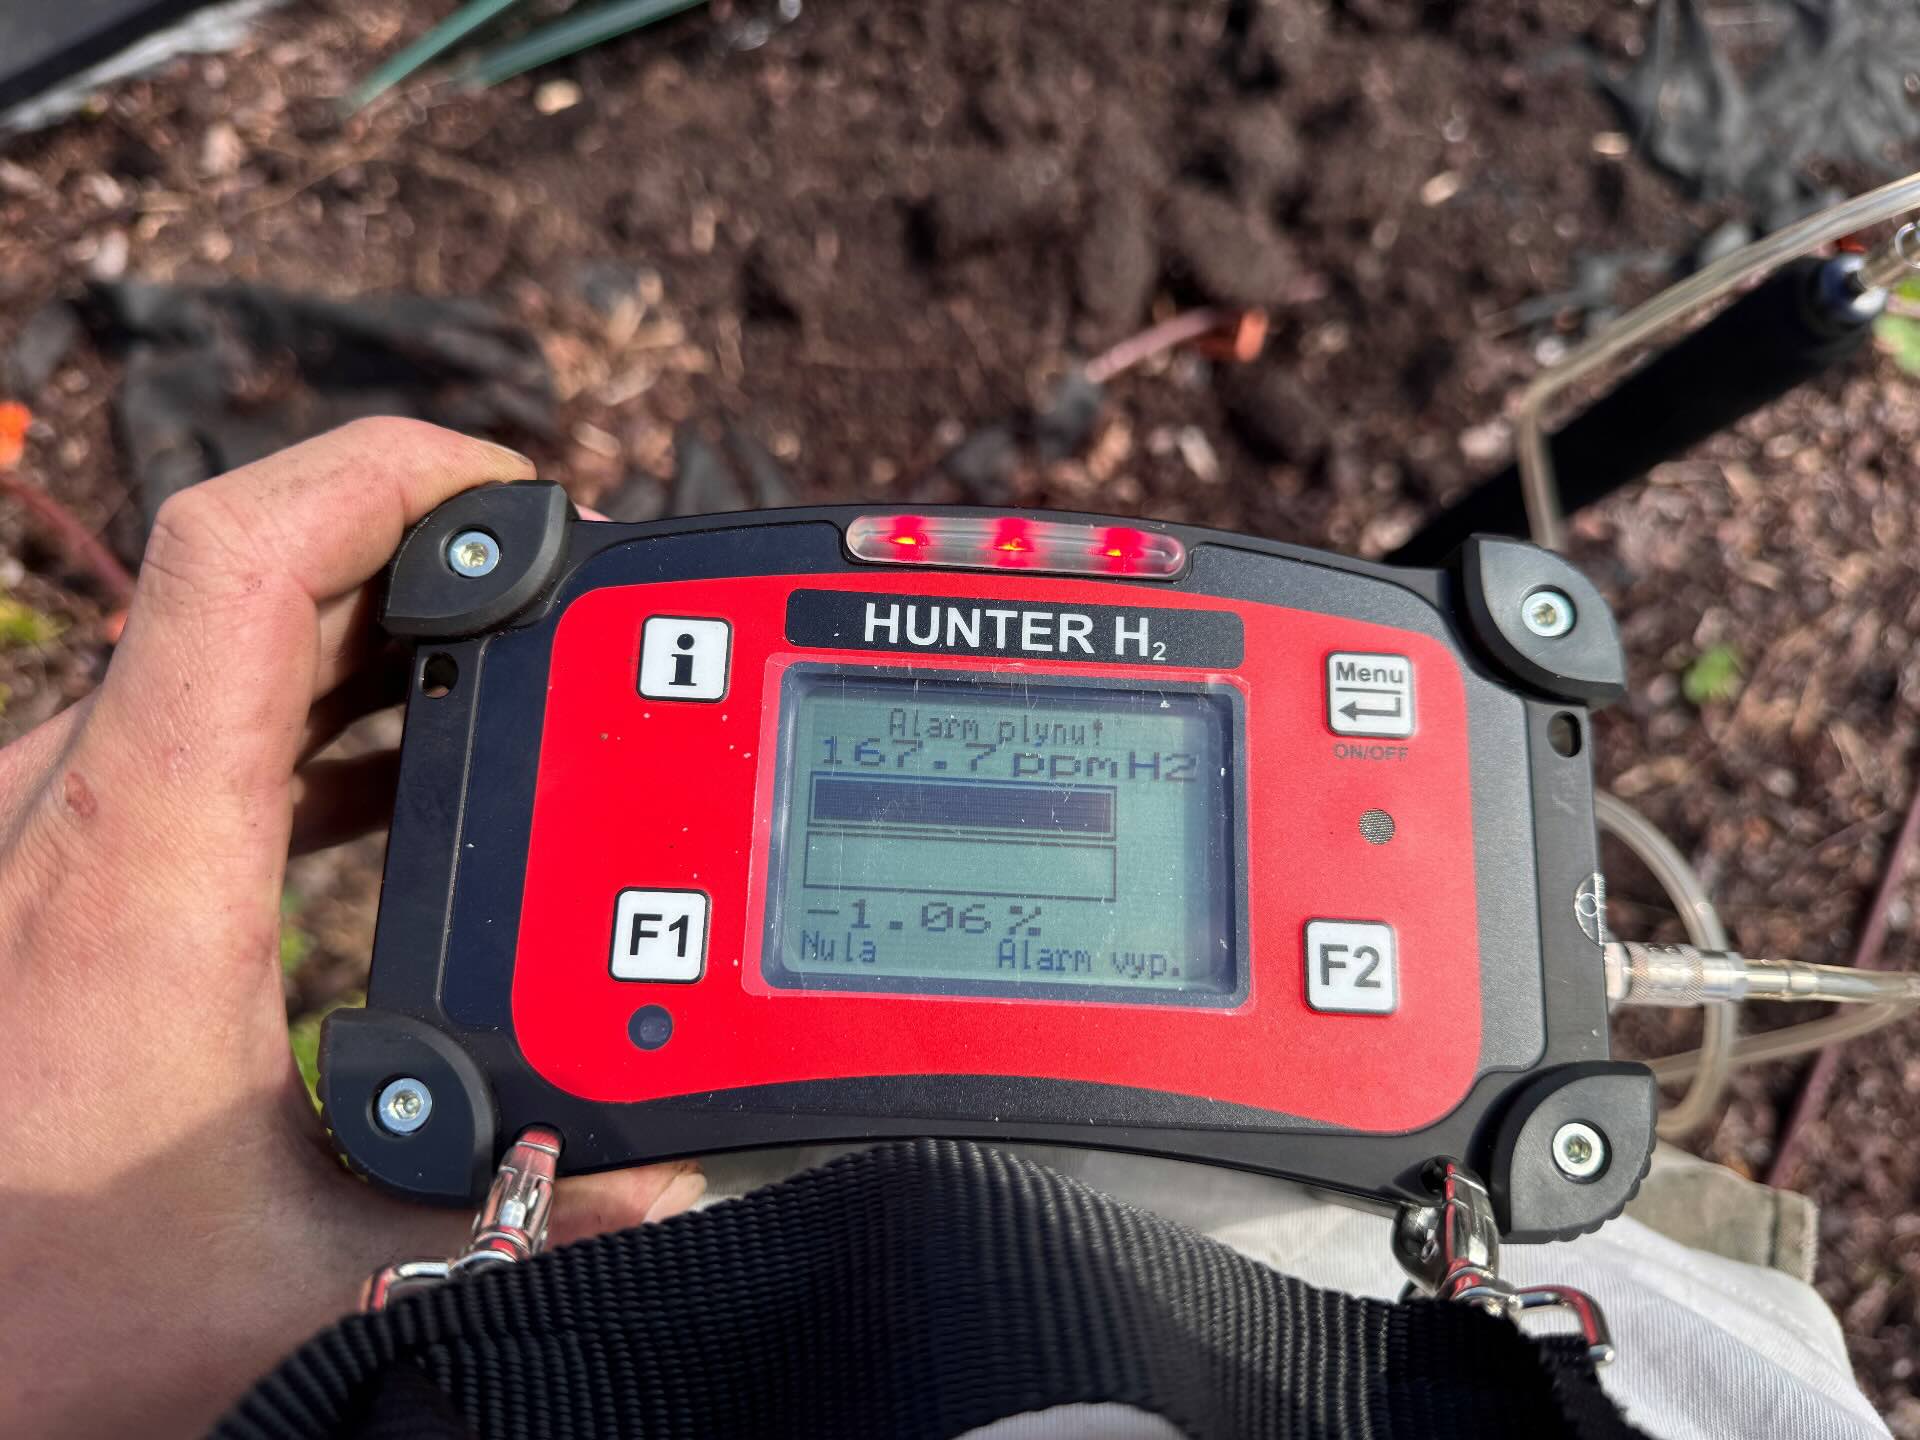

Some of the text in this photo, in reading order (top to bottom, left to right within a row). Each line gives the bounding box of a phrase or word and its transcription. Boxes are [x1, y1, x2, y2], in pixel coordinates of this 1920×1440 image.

[864, 602, 1095, 655] HUNTER
[668, 632, 697, 687] i
[1335, 661, 1404, 685] Menu
[889, 708, 1105, 748] Alarm plynu!
[1332, 742, 1409, 761] ON/OFF
[629, 912, 691, 958] F1
[800, 929, 877, 963] Nula
[999, 938, 1182, 980] Alarm vyp.
[1319, 943, 1382, 988] F2
